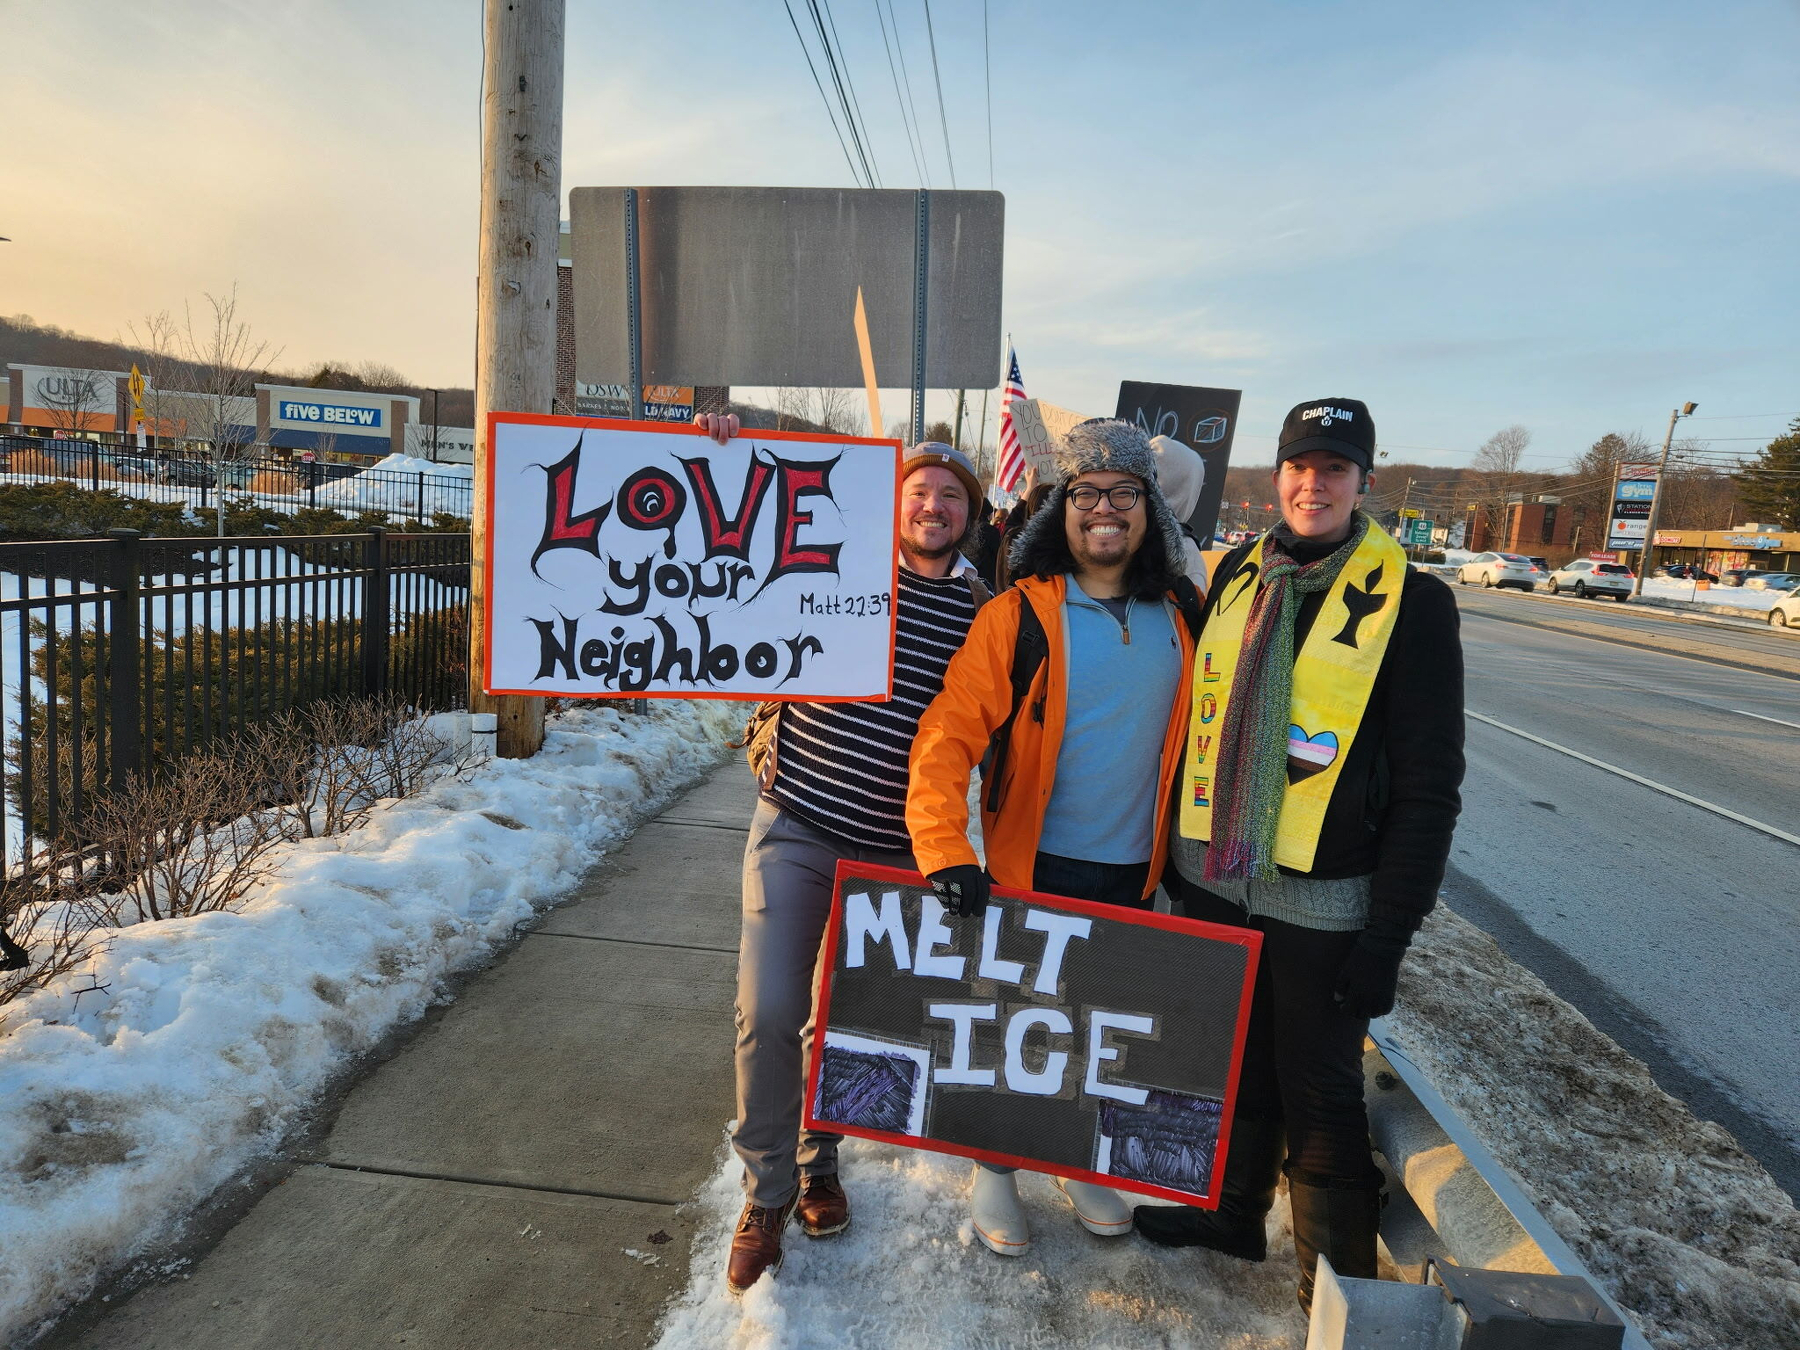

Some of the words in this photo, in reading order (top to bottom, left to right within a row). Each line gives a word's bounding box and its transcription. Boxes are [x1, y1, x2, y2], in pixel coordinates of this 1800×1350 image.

[586, 384, 622, 397] DSW
[285, 403, 320, 421] five
[323, 407, 375, 425] BELOW
[1011, 403, 1041, 427] YOU
[1135, 405, 1179, 441] NO
[1302, 406, 1354, 422] CHAPLAIN
[421, 440, 455, 450] MN'S
[1023, 424, 1048, 443] TO
[523, 425, 850, 606] LOVE
[597, 550, 756, 616] your
[799, 592, 842, 616] Matt
[524, 605, 824, 692] Neighbor
[1193, 652, 1222, 807] LOVE
[845, 890, 1092, 997] MELT
[929, 1003, 1154, 1106] ICE
